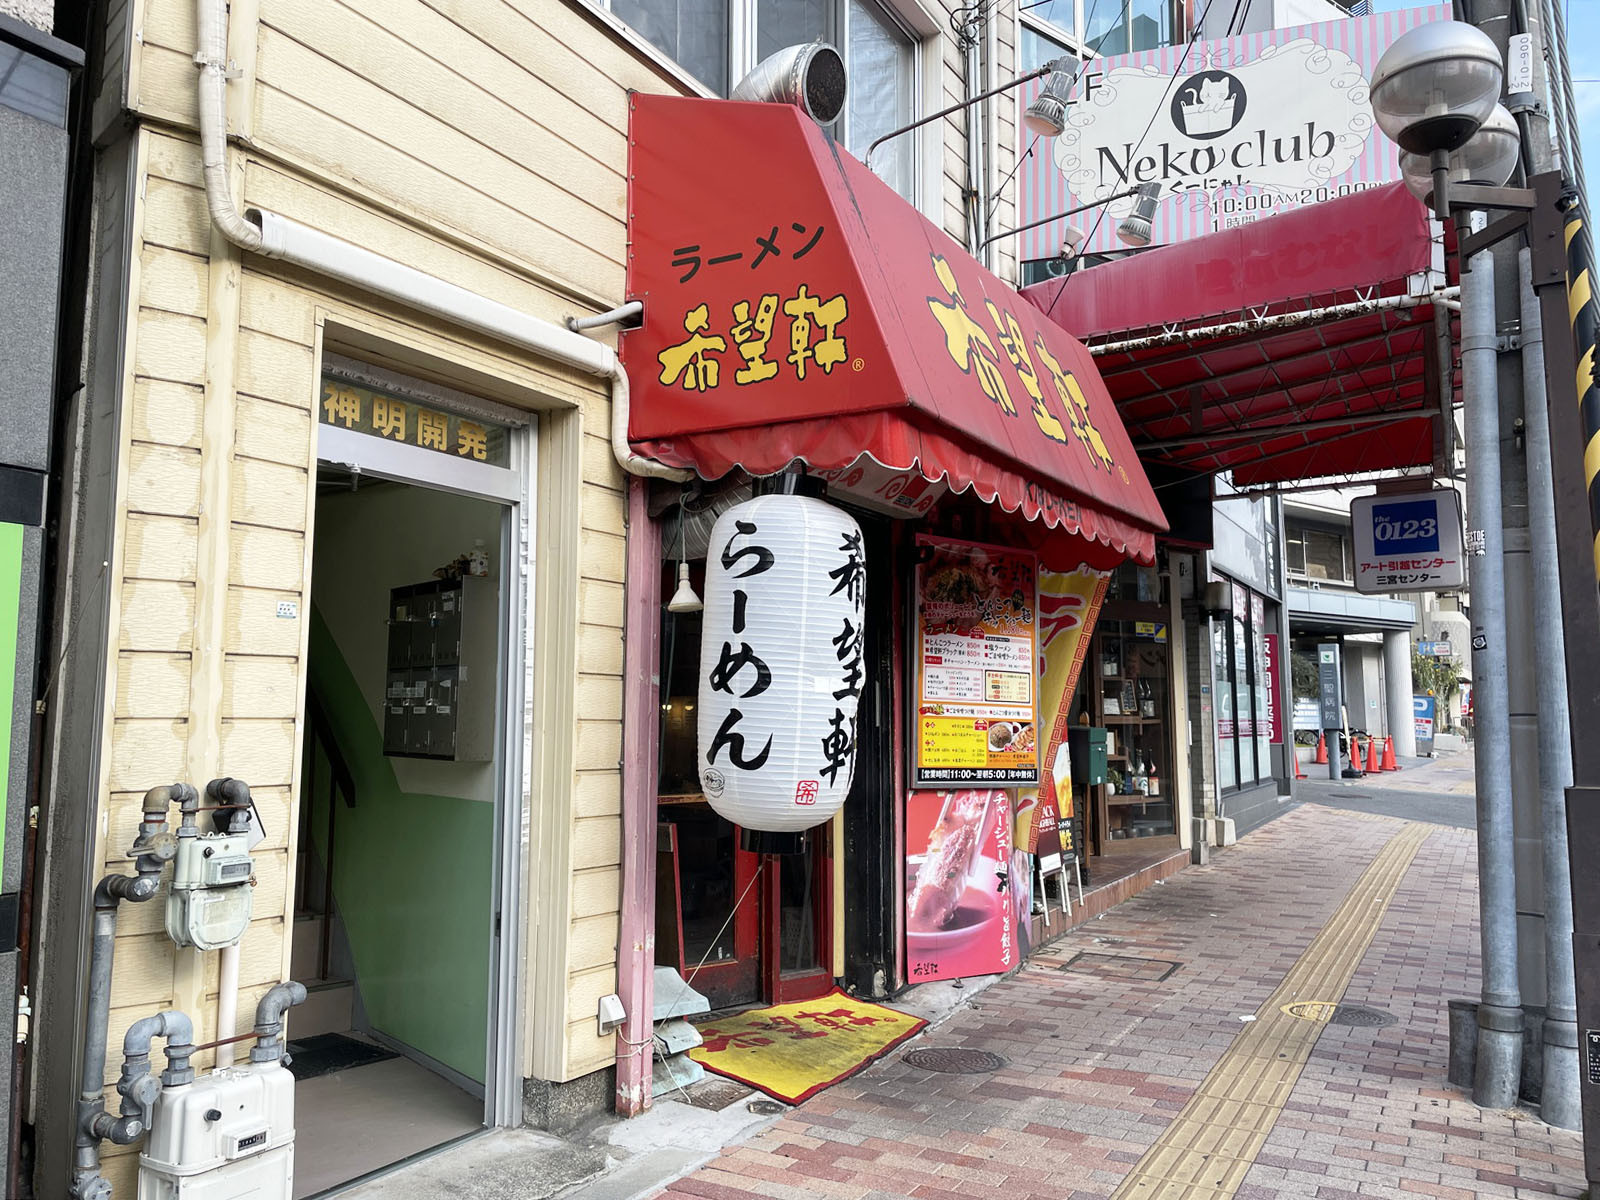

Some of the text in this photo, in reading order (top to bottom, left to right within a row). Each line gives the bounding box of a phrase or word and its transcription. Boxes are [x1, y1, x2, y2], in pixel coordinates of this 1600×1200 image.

[1095, 121, 1336, 188] Neko club
[671, 221, 825, 284] ラーメン
[657, 284, 849, 393] 希望軒
[925, 251, 1115, 476] 希望軒
[323, 382, 489, 461] 神明開発
[1360, 557, 1456, 573] アート引越センター
[1374, 518, 1437, 542] 0123
[1376, 573, 1441, 586] 三宮センター
[705, 519, 775, 771] らーめん
[817, 528, 868, 790] 希望軒
